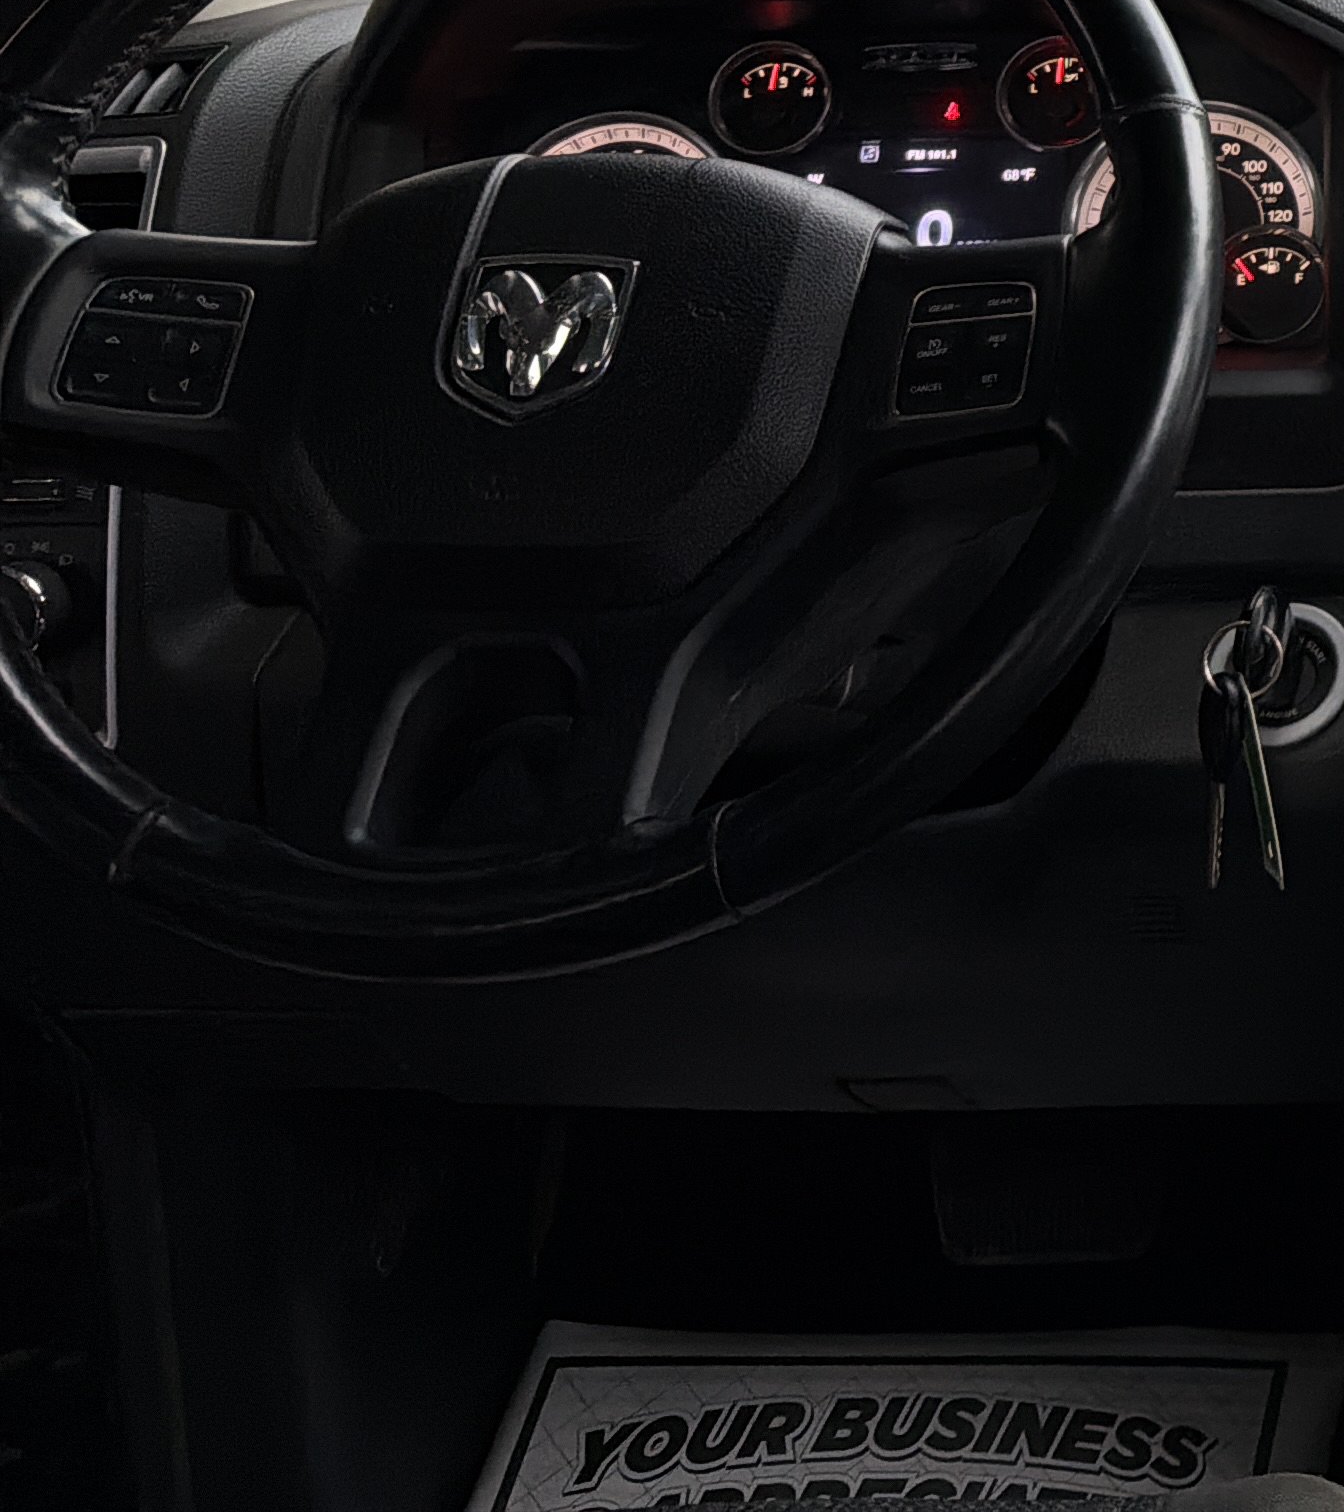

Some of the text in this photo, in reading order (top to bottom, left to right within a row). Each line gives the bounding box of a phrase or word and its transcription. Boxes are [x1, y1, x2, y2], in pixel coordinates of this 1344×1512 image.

[1221, 142, 1241, 156] 90
[1241, 159, 1268, 173] 100
[1260, 181, 1284, 195] 110
[1267, 209, 1293, 223] 120
[1236, 274, 1247, 286] E
[1294, 272, 1304, 285] F
[571, 1396, 1216, 1487] YOUR BUSINESS
